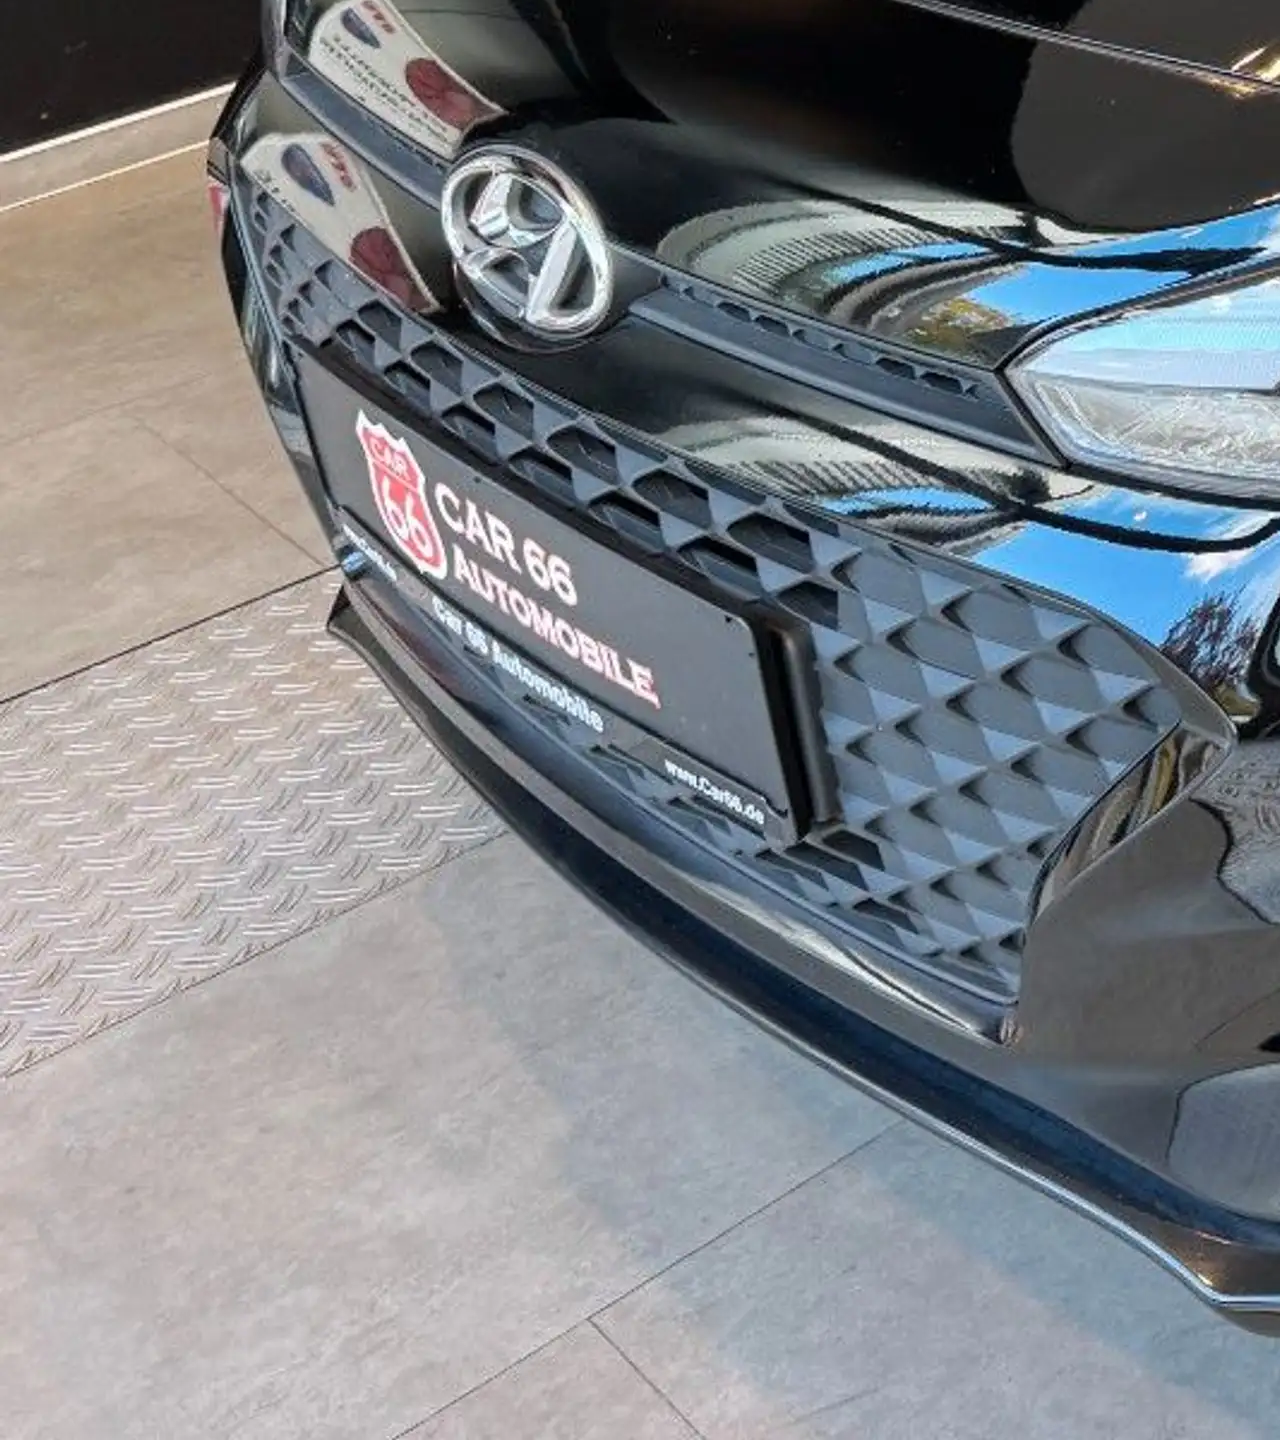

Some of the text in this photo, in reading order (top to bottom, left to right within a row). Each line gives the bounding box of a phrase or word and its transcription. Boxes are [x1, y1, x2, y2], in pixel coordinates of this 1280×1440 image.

[370, 438, 411, 481] CAR
[382, 476, 434, 560] 66
[434, 482, 522, 575] CAR
[523, 537, 577, 606] 66
[452, 543, 661, 710] AUTOMOBILE
